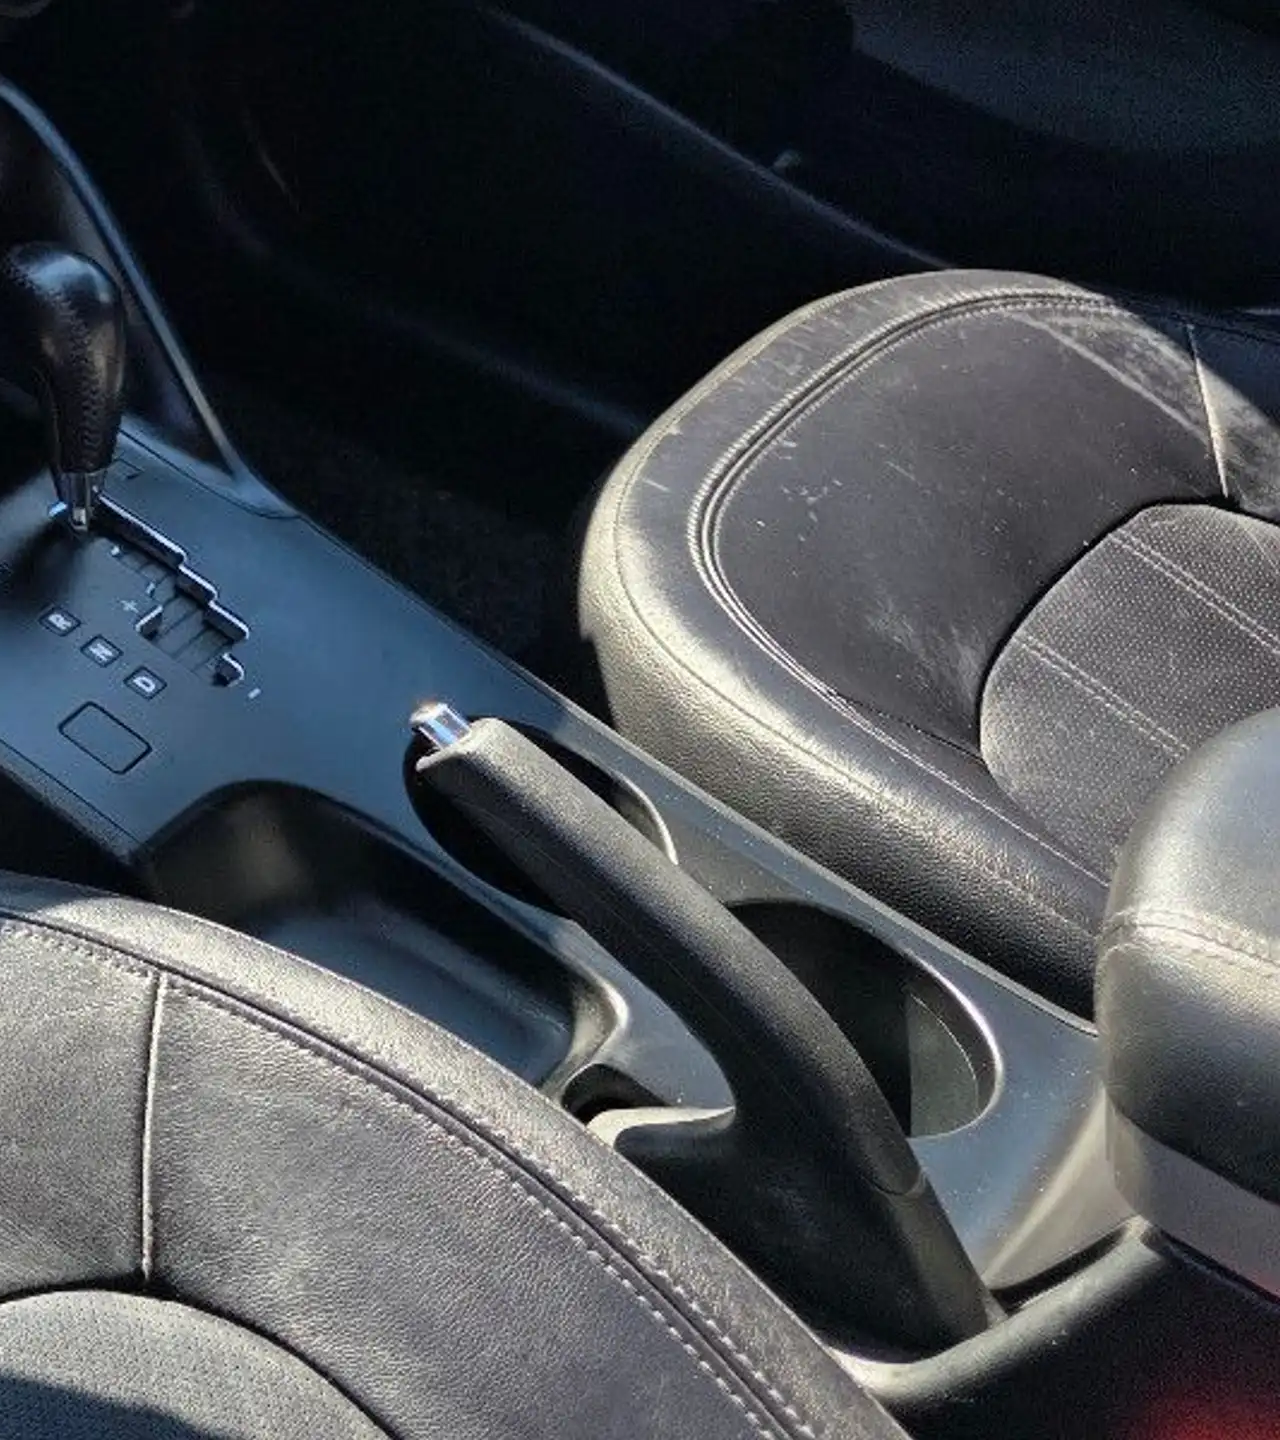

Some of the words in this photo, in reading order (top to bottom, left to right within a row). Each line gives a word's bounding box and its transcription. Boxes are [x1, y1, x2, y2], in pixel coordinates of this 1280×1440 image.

[48, 612, 73, 630] R
[89, 642, 113, 662] N
[134, 676, 156, 693] D
